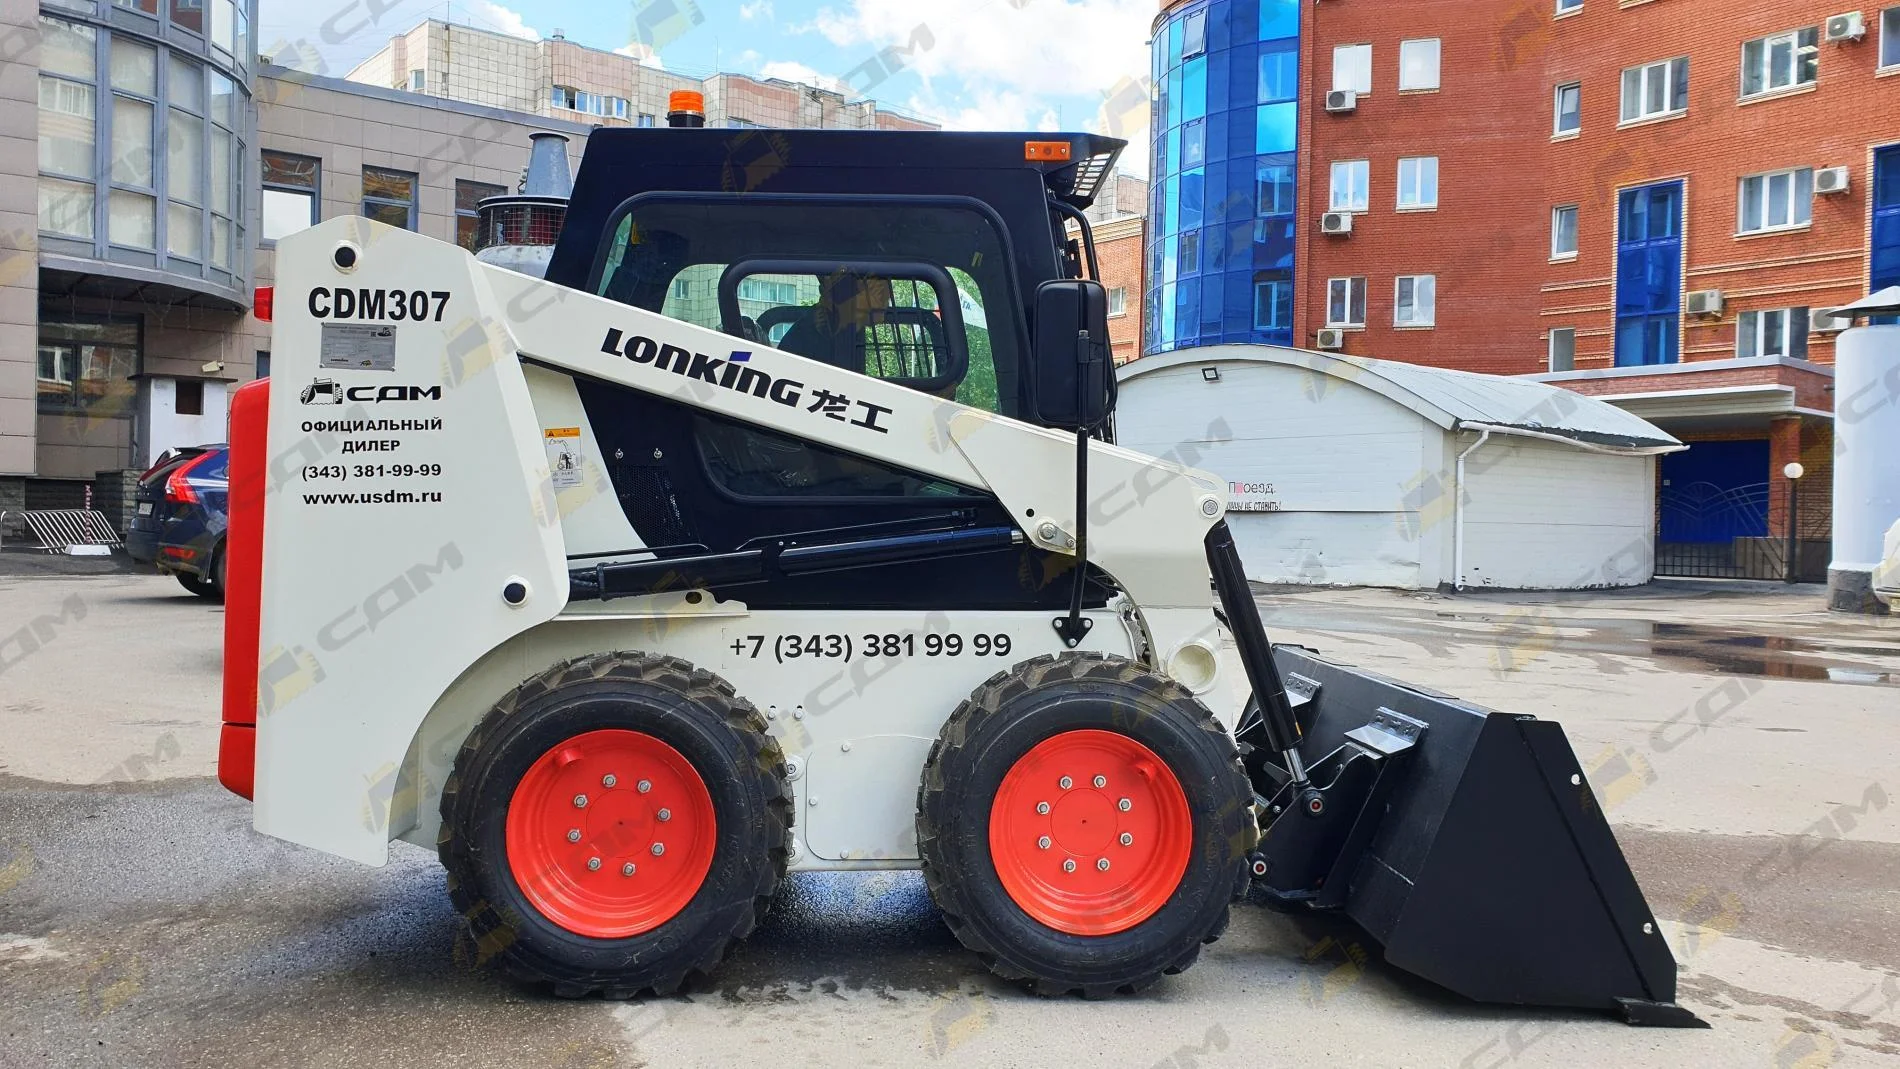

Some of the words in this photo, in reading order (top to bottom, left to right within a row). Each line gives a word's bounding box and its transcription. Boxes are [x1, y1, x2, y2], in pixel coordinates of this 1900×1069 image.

[308, 286, 451, 322] CDM307
[346, 385, 442, 404] СДМ
[806, 389, 894, 434] 龙工
[301, 416, 442, 434] ОФИЦИАЛЬНЫЙ
[341, 439, 401, 455] ДИЛЕР
[302, 465, 347, 482] (343)
[353, 463, 442, 478] 381-99-99
[302, 489, 442, 505] www.usdm.ru
[729, 635, 765, 659] +7
[774, 633, 853, 664] (343)
[862, 633, 914, 657] 381
[924, 633, 964, 657] 99
[973, 633, 1012, 657] 99
